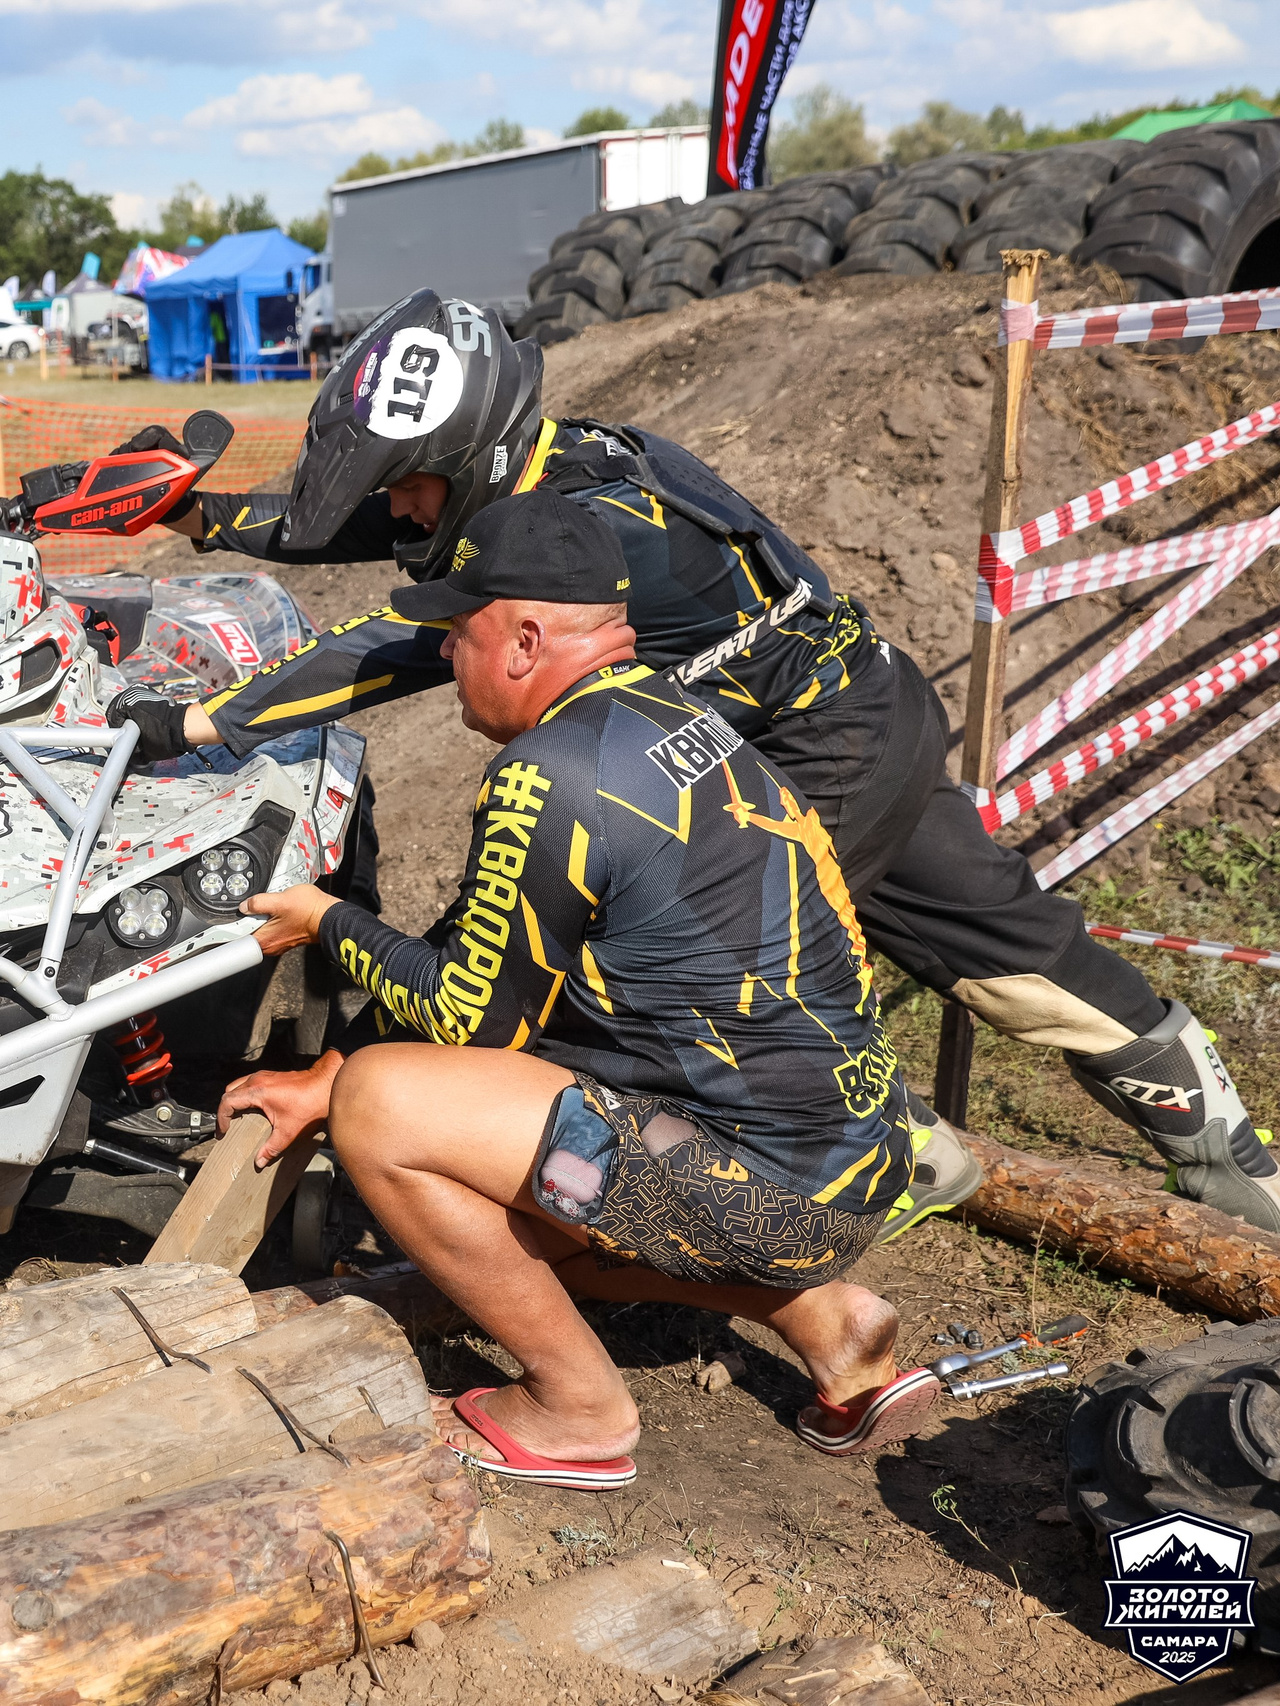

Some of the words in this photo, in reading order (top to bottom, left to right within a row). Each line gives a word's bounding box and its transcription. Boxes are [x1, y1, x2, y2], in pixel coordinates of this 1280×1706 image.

[388, 344, 440, 422] 119
[71, 495, 143, 527] can-am
[676, 615, 767, 686] LEATT
[1205, 1046, 1230, 1090] GTX
[1109, 1076, 1203, 1110] GTX
[768, 1249, 836, 1270] FILA
